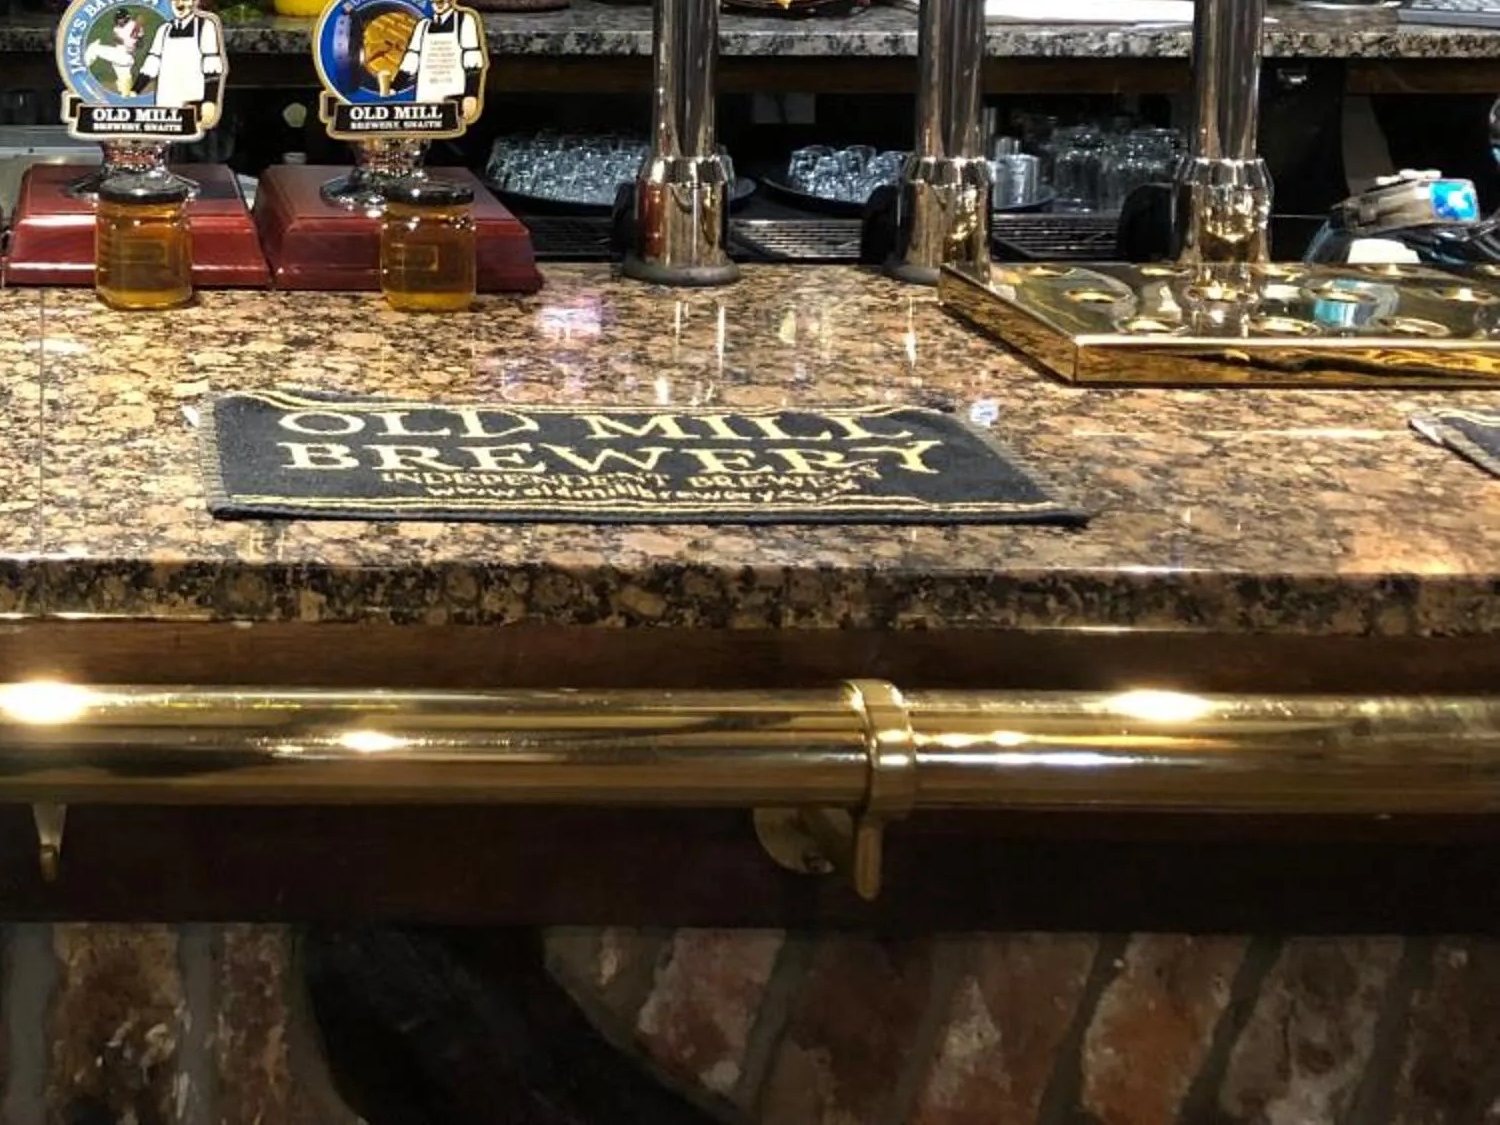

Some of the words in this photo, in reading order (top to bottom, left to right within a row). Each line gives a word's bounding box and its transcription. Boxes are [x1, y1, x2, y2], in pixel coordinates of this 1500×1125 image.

[66, 18, 88, 75] JACK'S
[92, 109, 131, 122] OLD
[134, 109, 183, 122] MILL
[349, 106, 389, 120] OLD
[393, 106, 443, 120] MILL
[277, 408, 540, 438] OLD
[570, 414, 914, 441] MILL
[275, 440, 945, 475] BREWERY
[382, 472, 671, 487] INDEPENDENT
